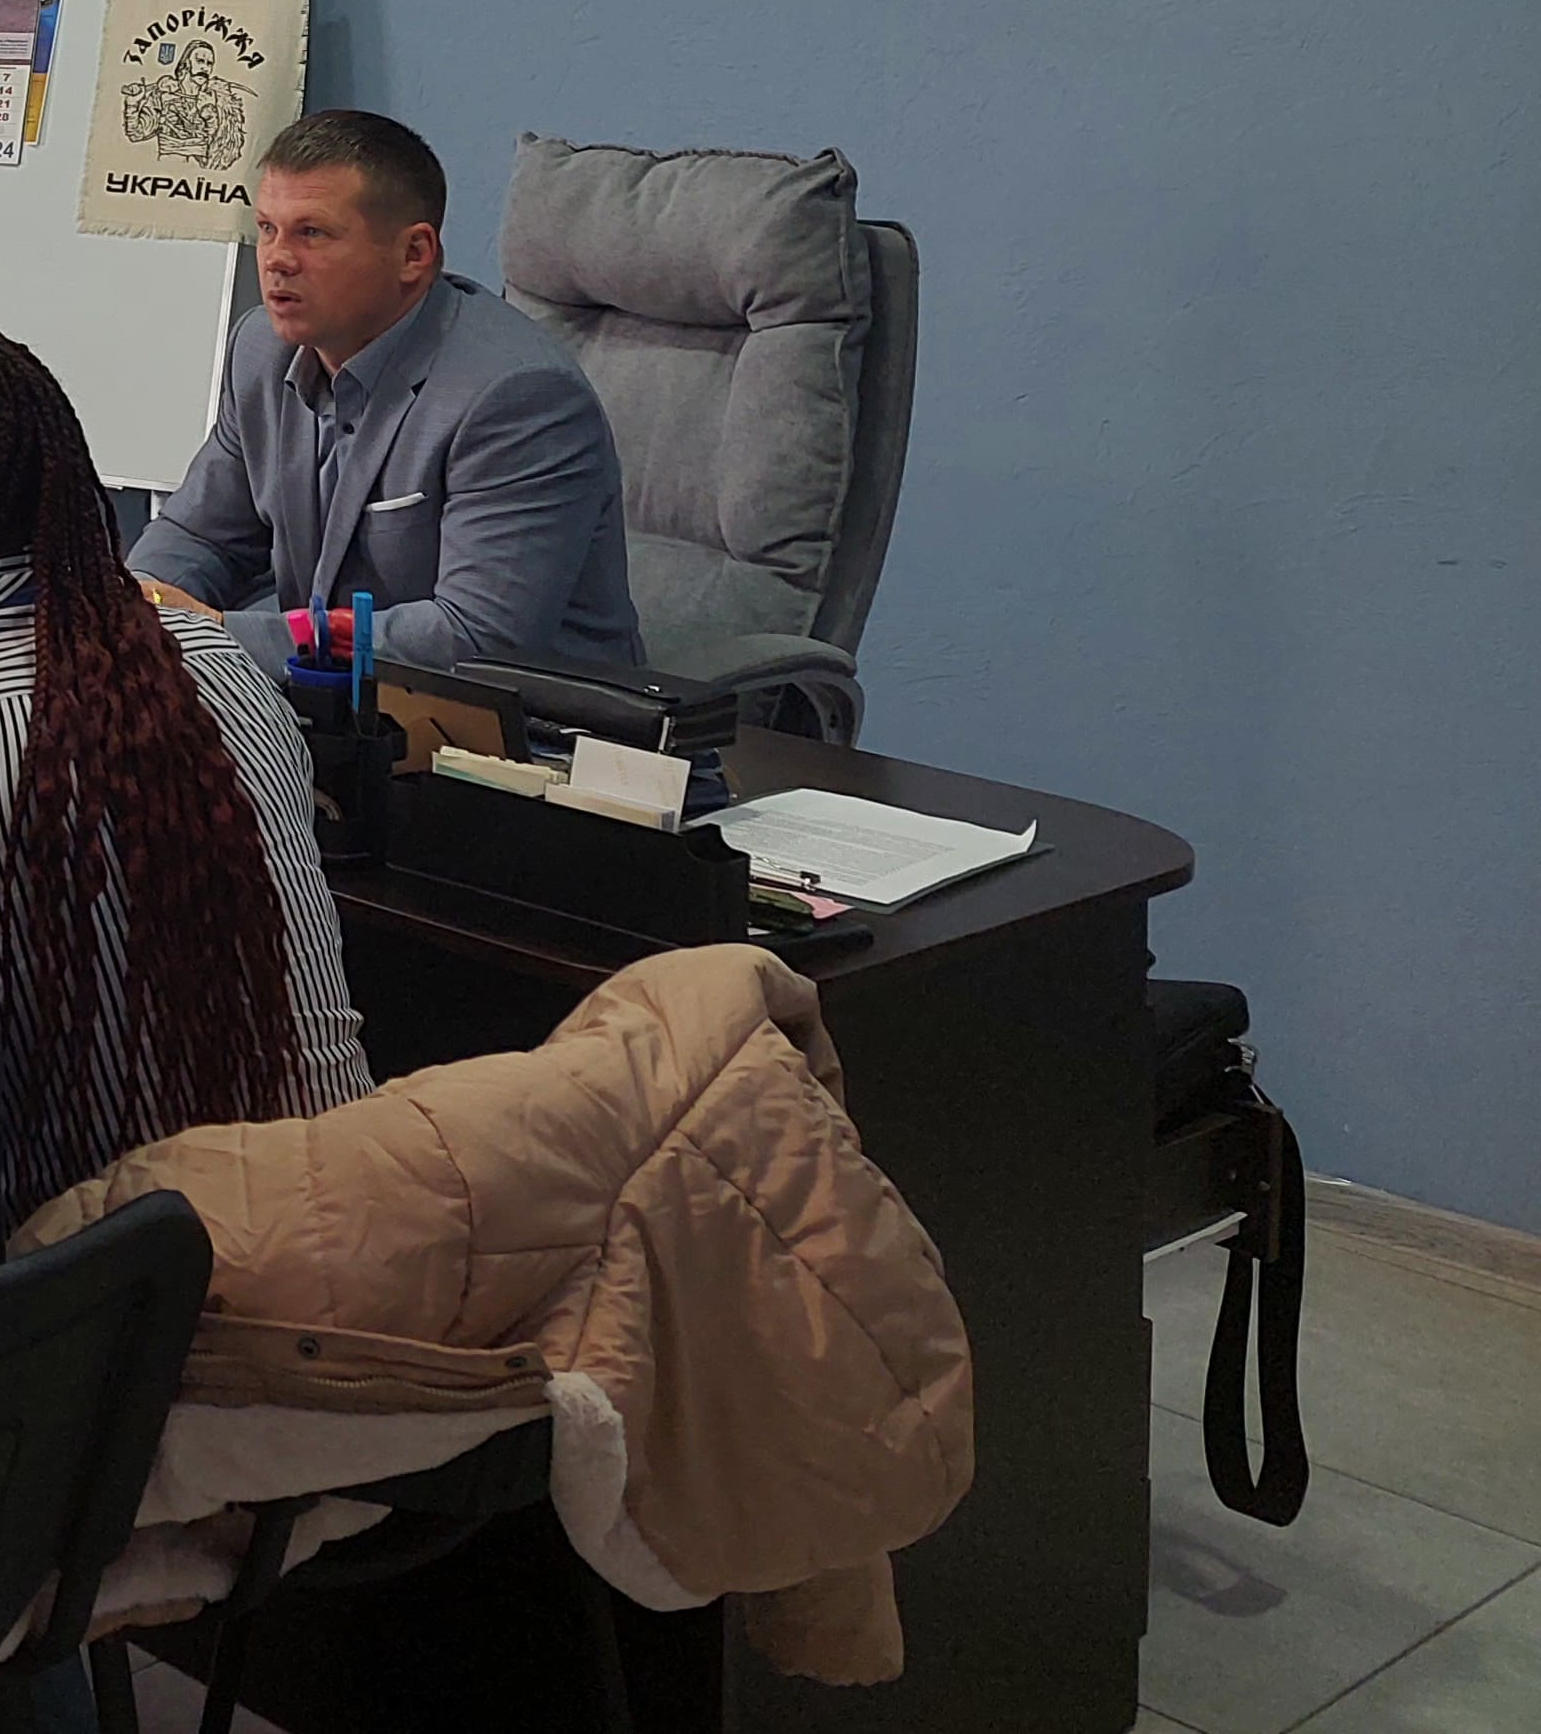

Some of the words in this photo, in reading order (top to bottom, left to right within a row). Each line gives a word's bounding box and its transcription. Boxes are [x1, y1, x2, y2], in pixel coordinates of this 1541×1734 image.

[123, 6, 265, 69] ЗАПОРІЖЖЯ
[2, 72, 12, 82] 7
[105, 172, 253, 207] УКРАЇНА
